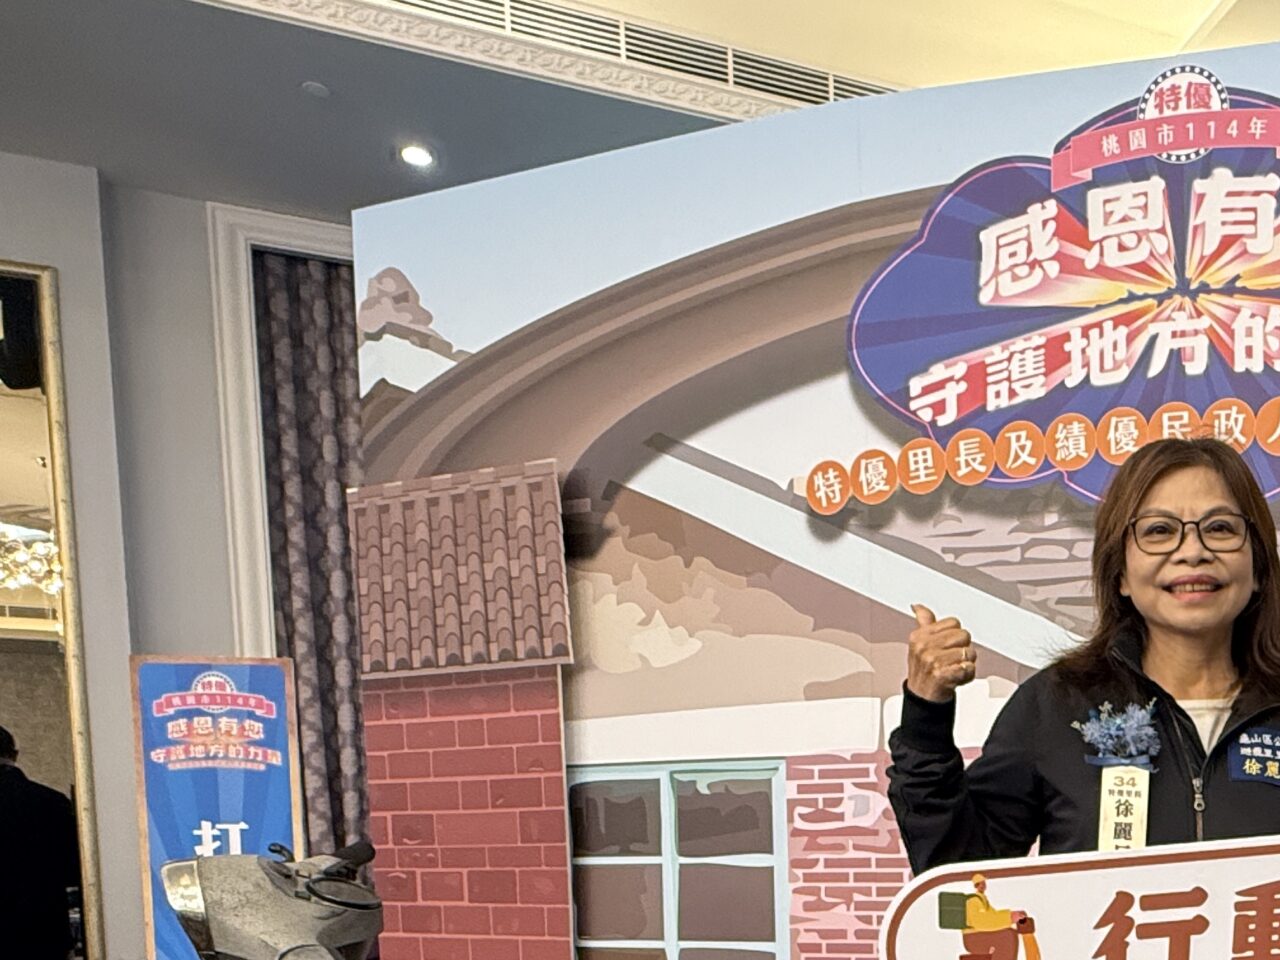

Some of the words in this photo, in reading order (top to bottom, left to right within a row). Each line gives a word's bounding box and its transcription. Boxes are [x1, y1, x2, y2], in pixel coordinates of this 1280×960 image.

[1154, 81, 1213, 115] 特優
[1101, 116, 1267, 157] 桃園市114年
[167, 716, 264, 739] 感恩有您
[1113, 776, 1137, 787] 34
[1113, 799, 1134, 850] 徐麗
